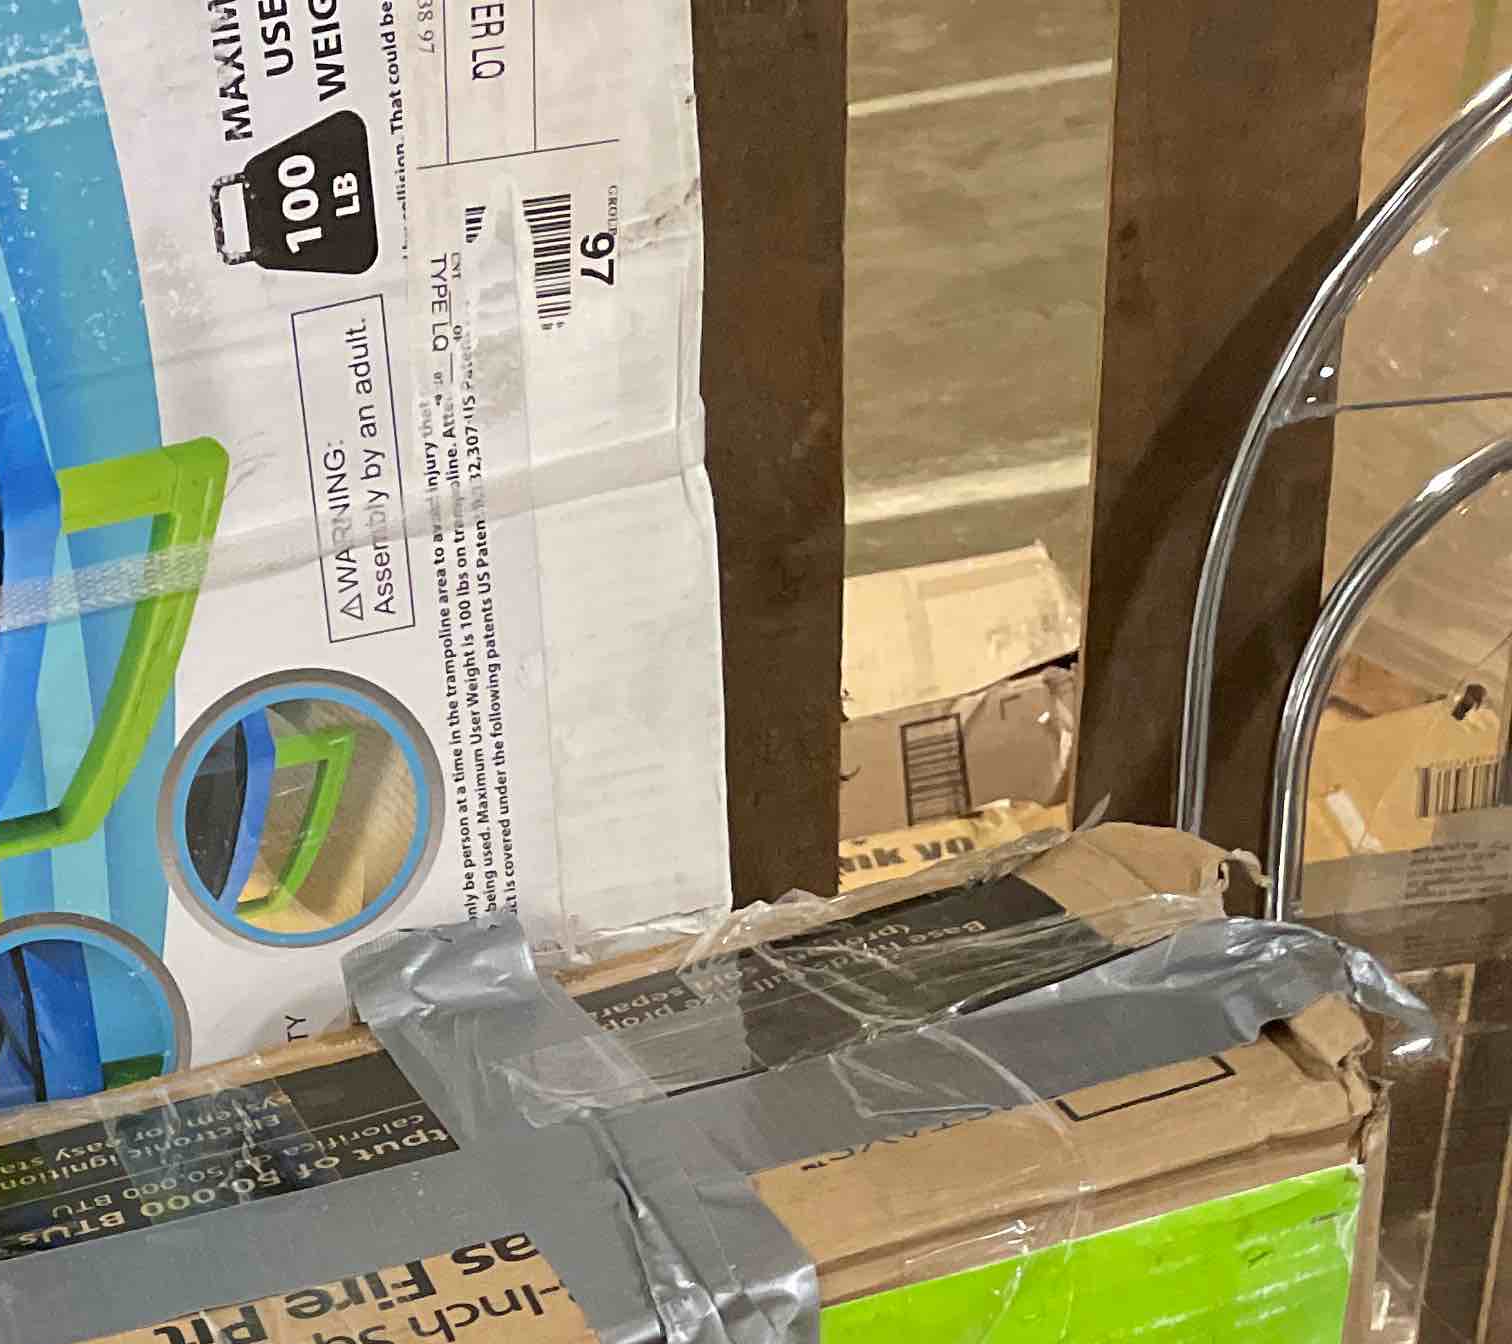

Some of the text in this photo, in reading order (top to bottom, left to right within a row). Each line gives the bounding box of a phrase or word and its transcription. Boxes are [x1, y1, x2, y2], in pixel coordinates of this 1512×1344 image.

[381, 31, 400, 85] could
[418, 31, 434, 54] 97
[472, 46, 505, 80] LQ
[388, 89, 405, 135] That
[278, 154, 322, 254] 100
[333, 172, 360, 217] LB
[580, 232, 615, 286] 97
[430, 252, 448, 314] TYPE
[432, 322, 449, 352] LQ
[345, 318, 373, 394] adult.
[358, 404, 377, 438] an
[361, 449, 385, 480] by
[424, 441, 440, 492] injury
[324, 439, 359, 593] WARNING:
[434, 547, 445, 565] to
[437, 568, 449, 603] area
[477, 572, 491, 594] US
[481, 597, 500, 659] patents
[438, 607, 457, 698] trampoline
[447, 701, 460, 727] the
[487, 662, 503, 738] following
[449, 728, 462, 745] in
[456, 546, 497, 912] being used. Maximum User Weight is 100 lbs on
[453, 748, 465, 783] time
[492, 741, 505, 766] the
[457, 785, 466, 794] a
[457, 798, 468, 814] at
[495, 770, 510, 815] under
[460, 816, 476, 868] person
[498, 819, 514, 877] covered
[463, 871, 475, 891] be
[504, 880, 516, 892] is
[0, 1153, 118, 1191] ignition
[295, 1155, 341, 1179] of
[52, 1193, 113, 1218] BTU
[19, 1210, 125, 1246] BTUs
[285, 1259, 437, 1320] Fire
